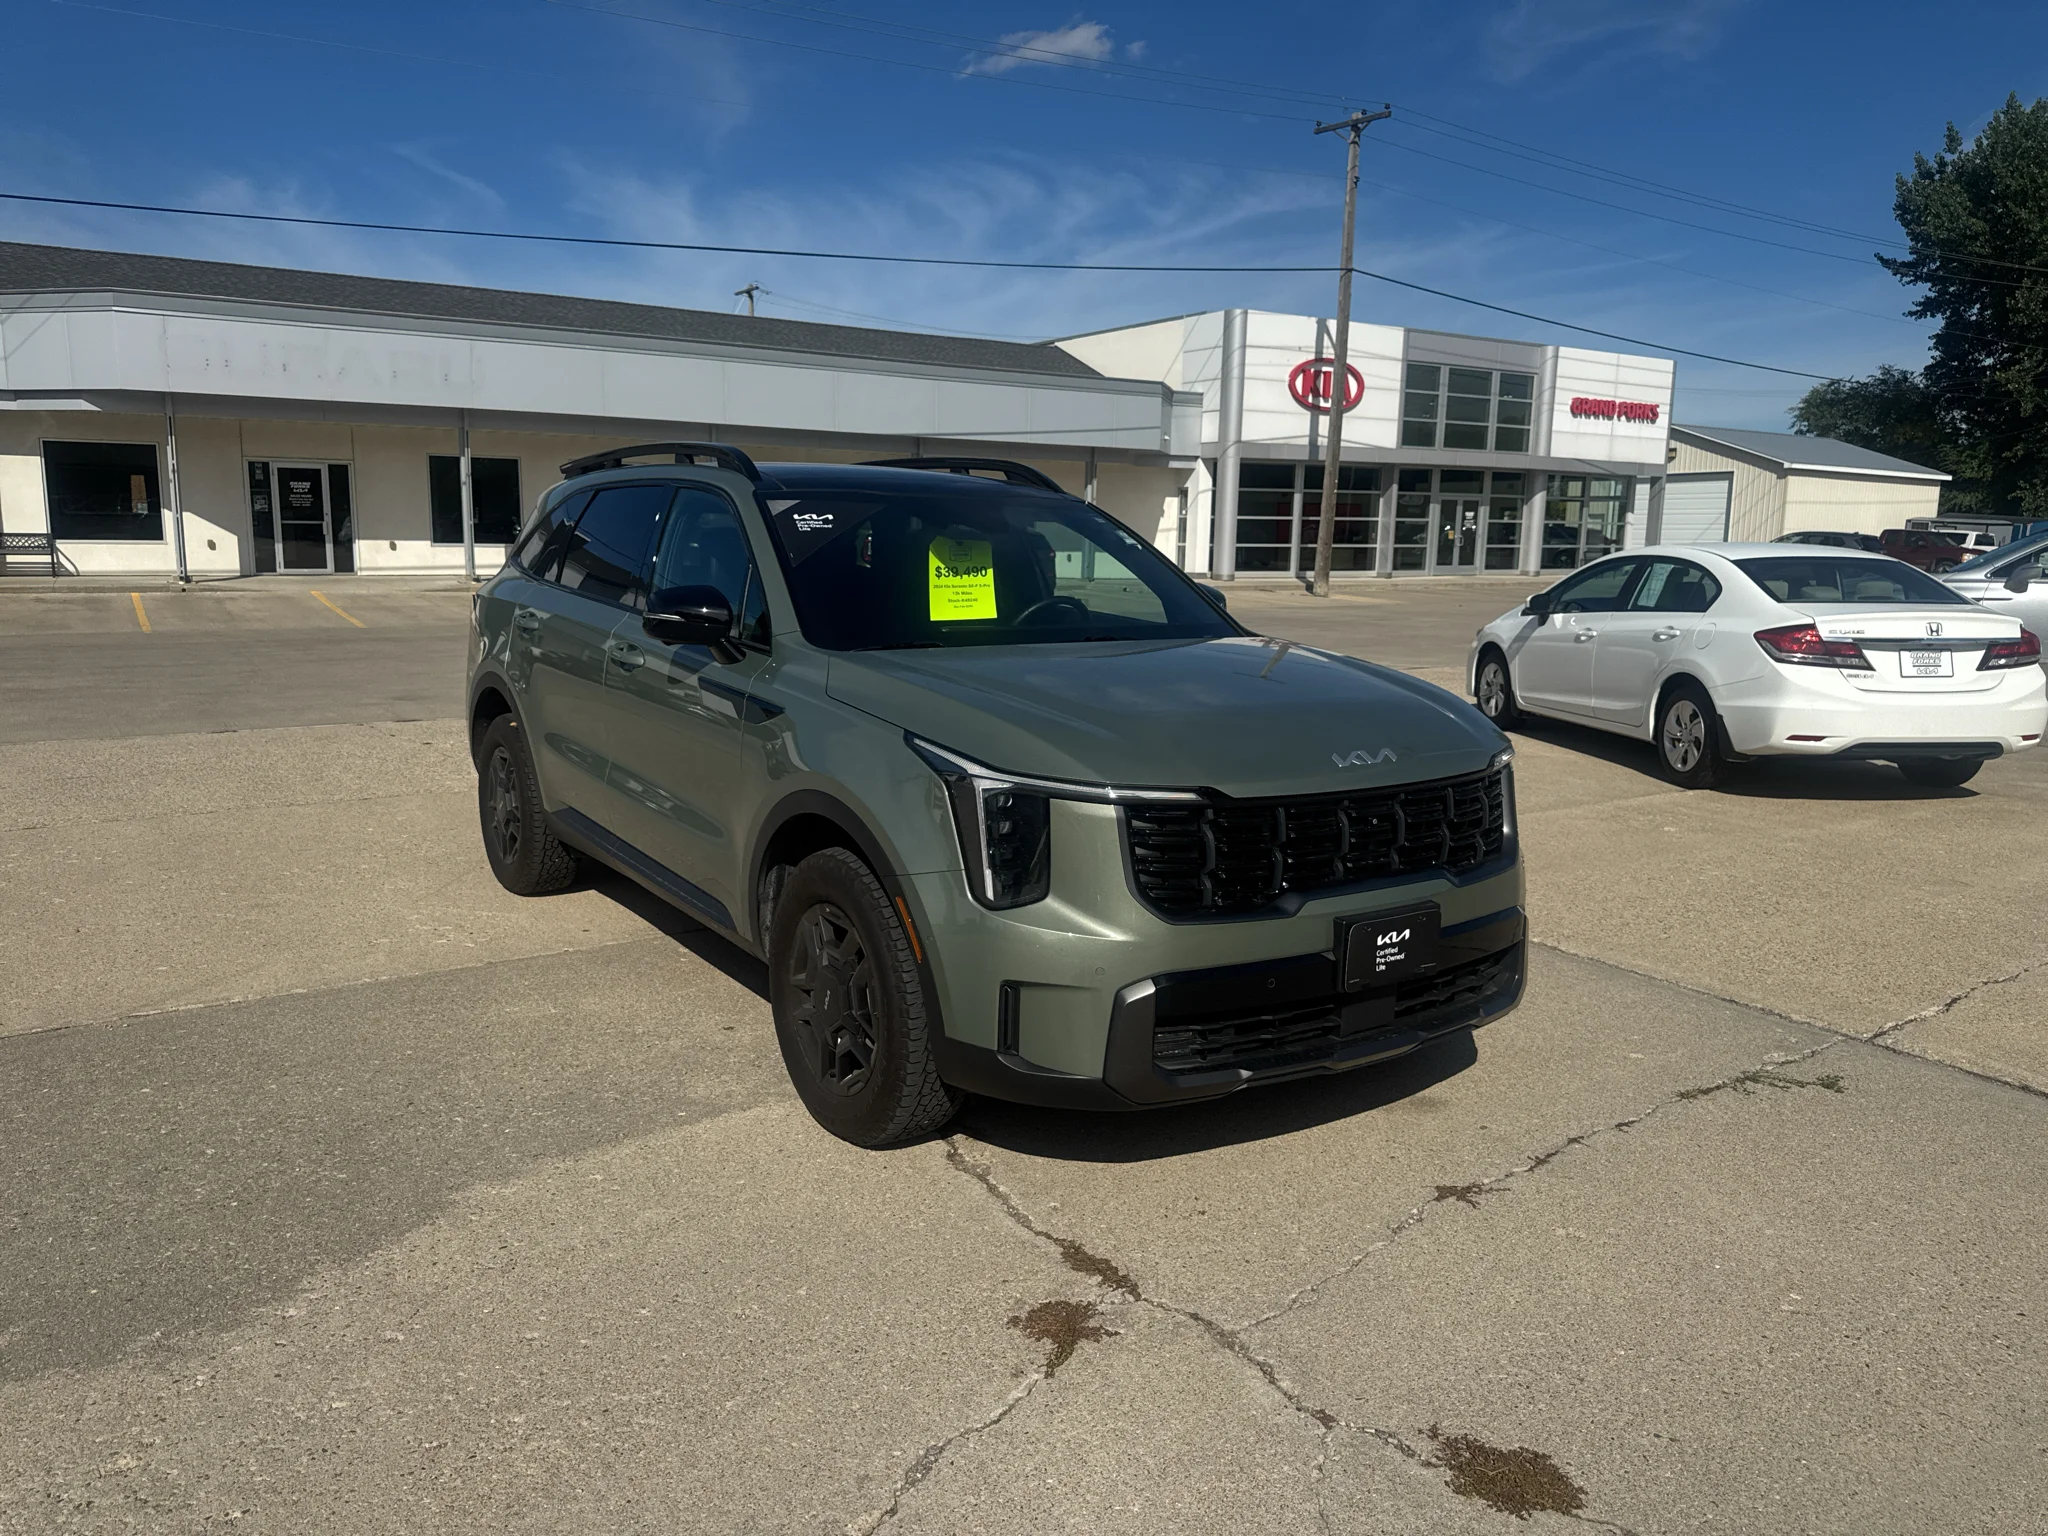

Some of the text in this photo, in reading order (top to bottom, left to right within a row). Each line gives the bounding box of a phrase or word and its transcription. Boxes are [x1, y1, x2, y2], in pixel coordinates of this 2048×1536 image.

[1570, 397, 1660, 420] GRAND FORKS
[934, 565, 988, 580] $39,490
[1916, 667, 1939, 675] KIA
[1331, 748, 1398, 767] KIA
[1377, 928, 1410, 946] KIA
[1376, 946, 1399, 957] Certified
[1376, 952, 1405, 964] Pre-Owned
